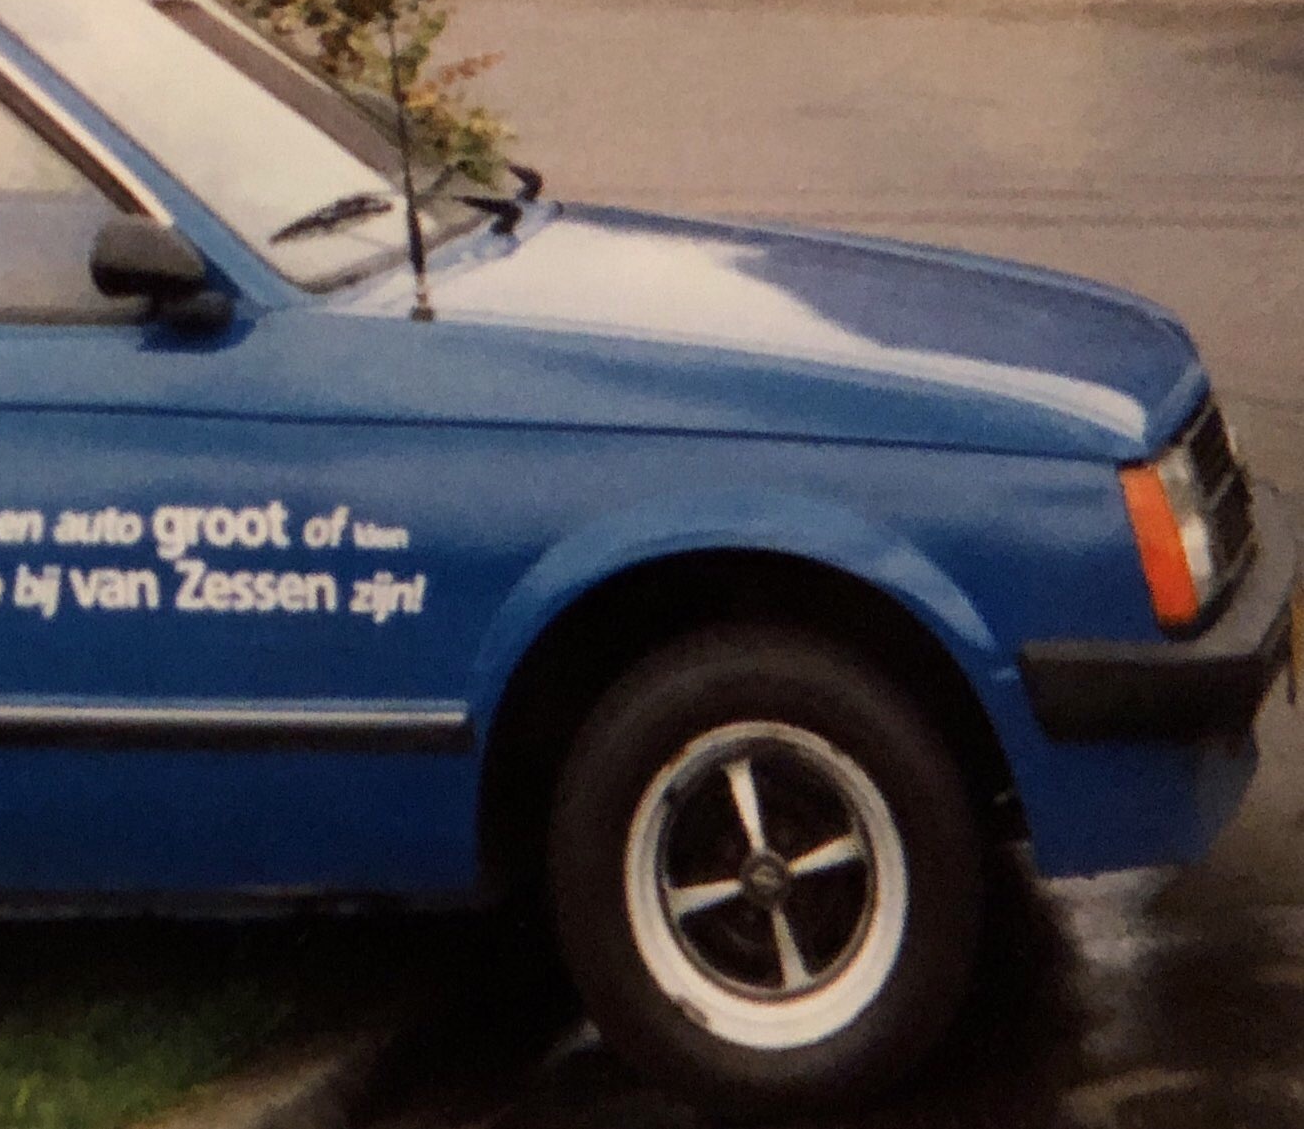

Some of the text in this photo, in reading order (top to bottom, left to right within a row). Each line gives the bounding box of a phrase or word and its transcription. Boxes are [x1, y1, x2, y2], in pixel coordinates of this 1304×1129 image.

[53, 507, 144, 545] auto
[152, 501, 290, 559] groot
[303, 505, 350, 548] of
[14, 564, 63, 617] bij
[69, 569, 159, 610] van
[174, 561, 337, 613] Zessen
[349, 571, 427, 623] zijn!
